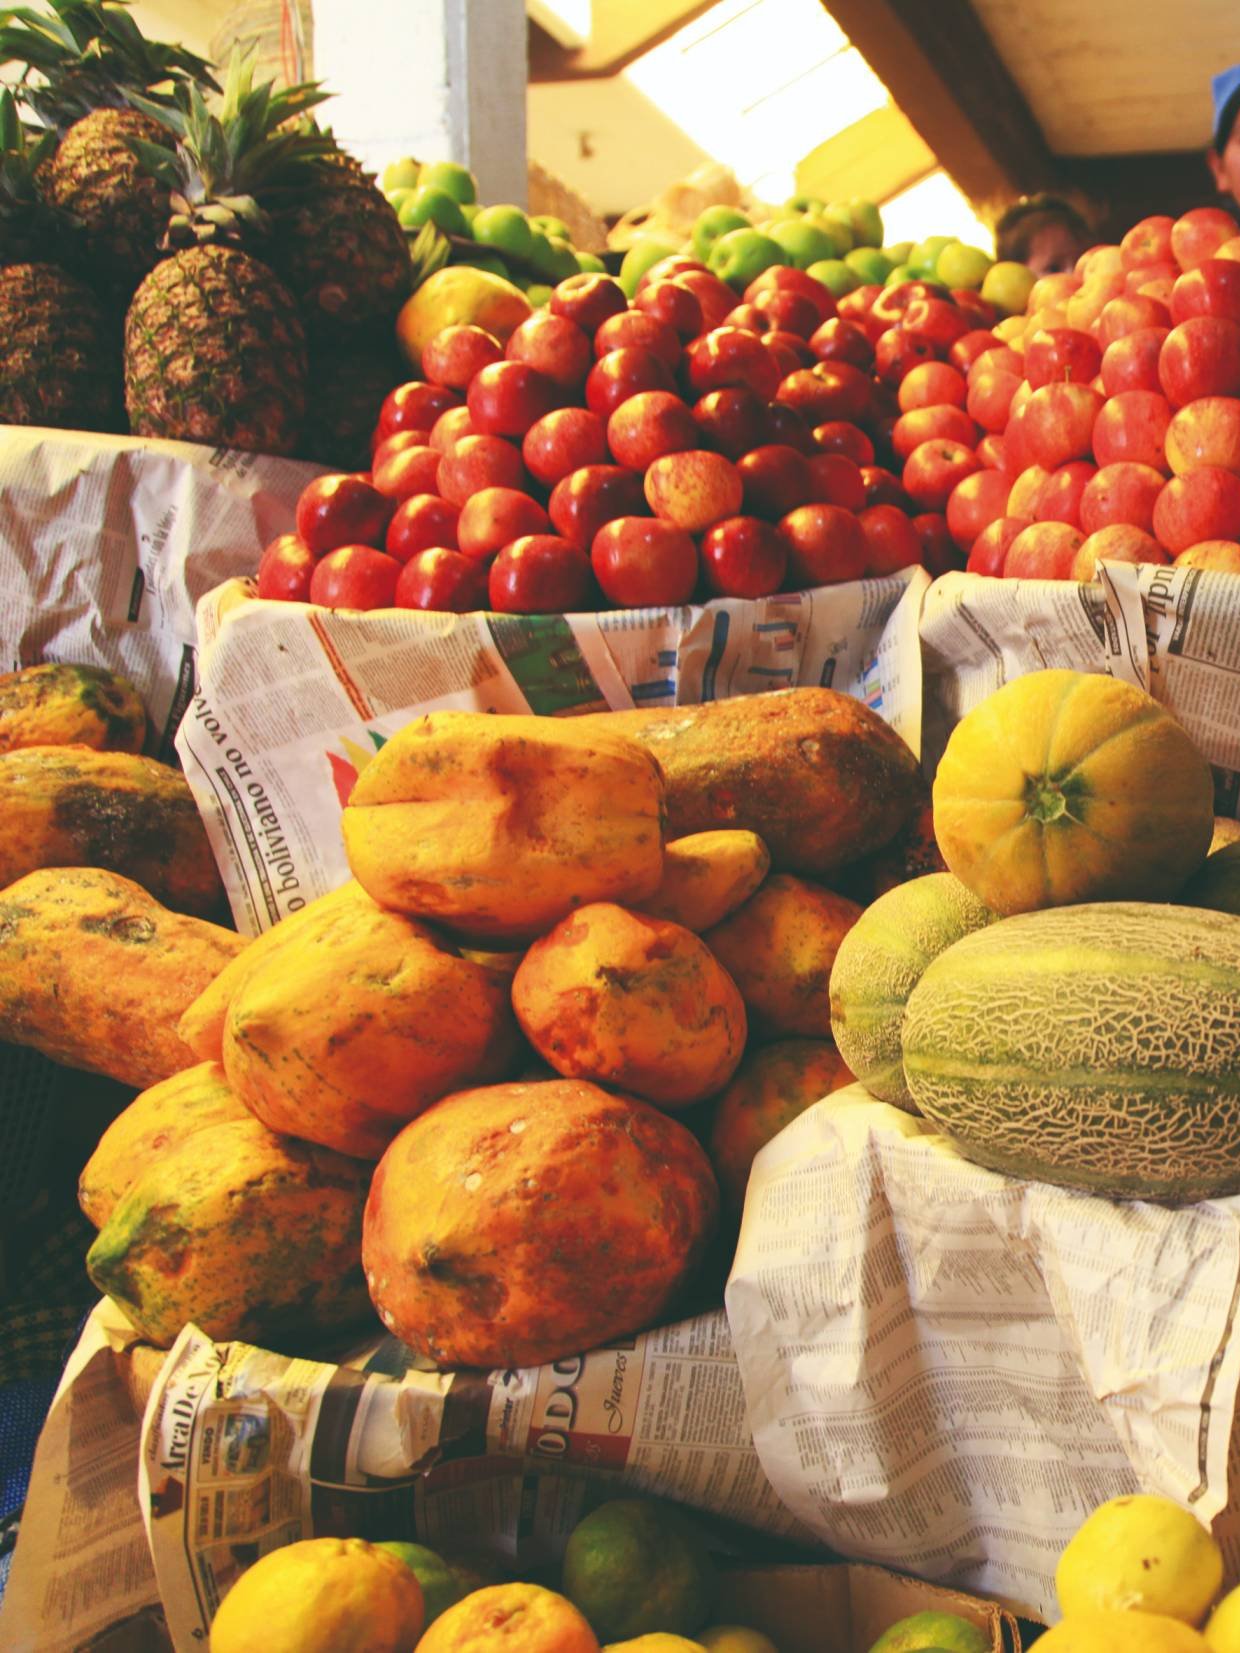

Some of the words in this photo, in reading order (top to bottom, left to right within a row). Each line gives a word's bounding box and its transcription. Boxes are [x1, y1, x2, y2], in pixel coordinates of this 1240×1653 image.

[225, 747, 252, 779] no
[247, 782, 300, 894] boliviano
[603, 1352, 627, 1434] Jueves
